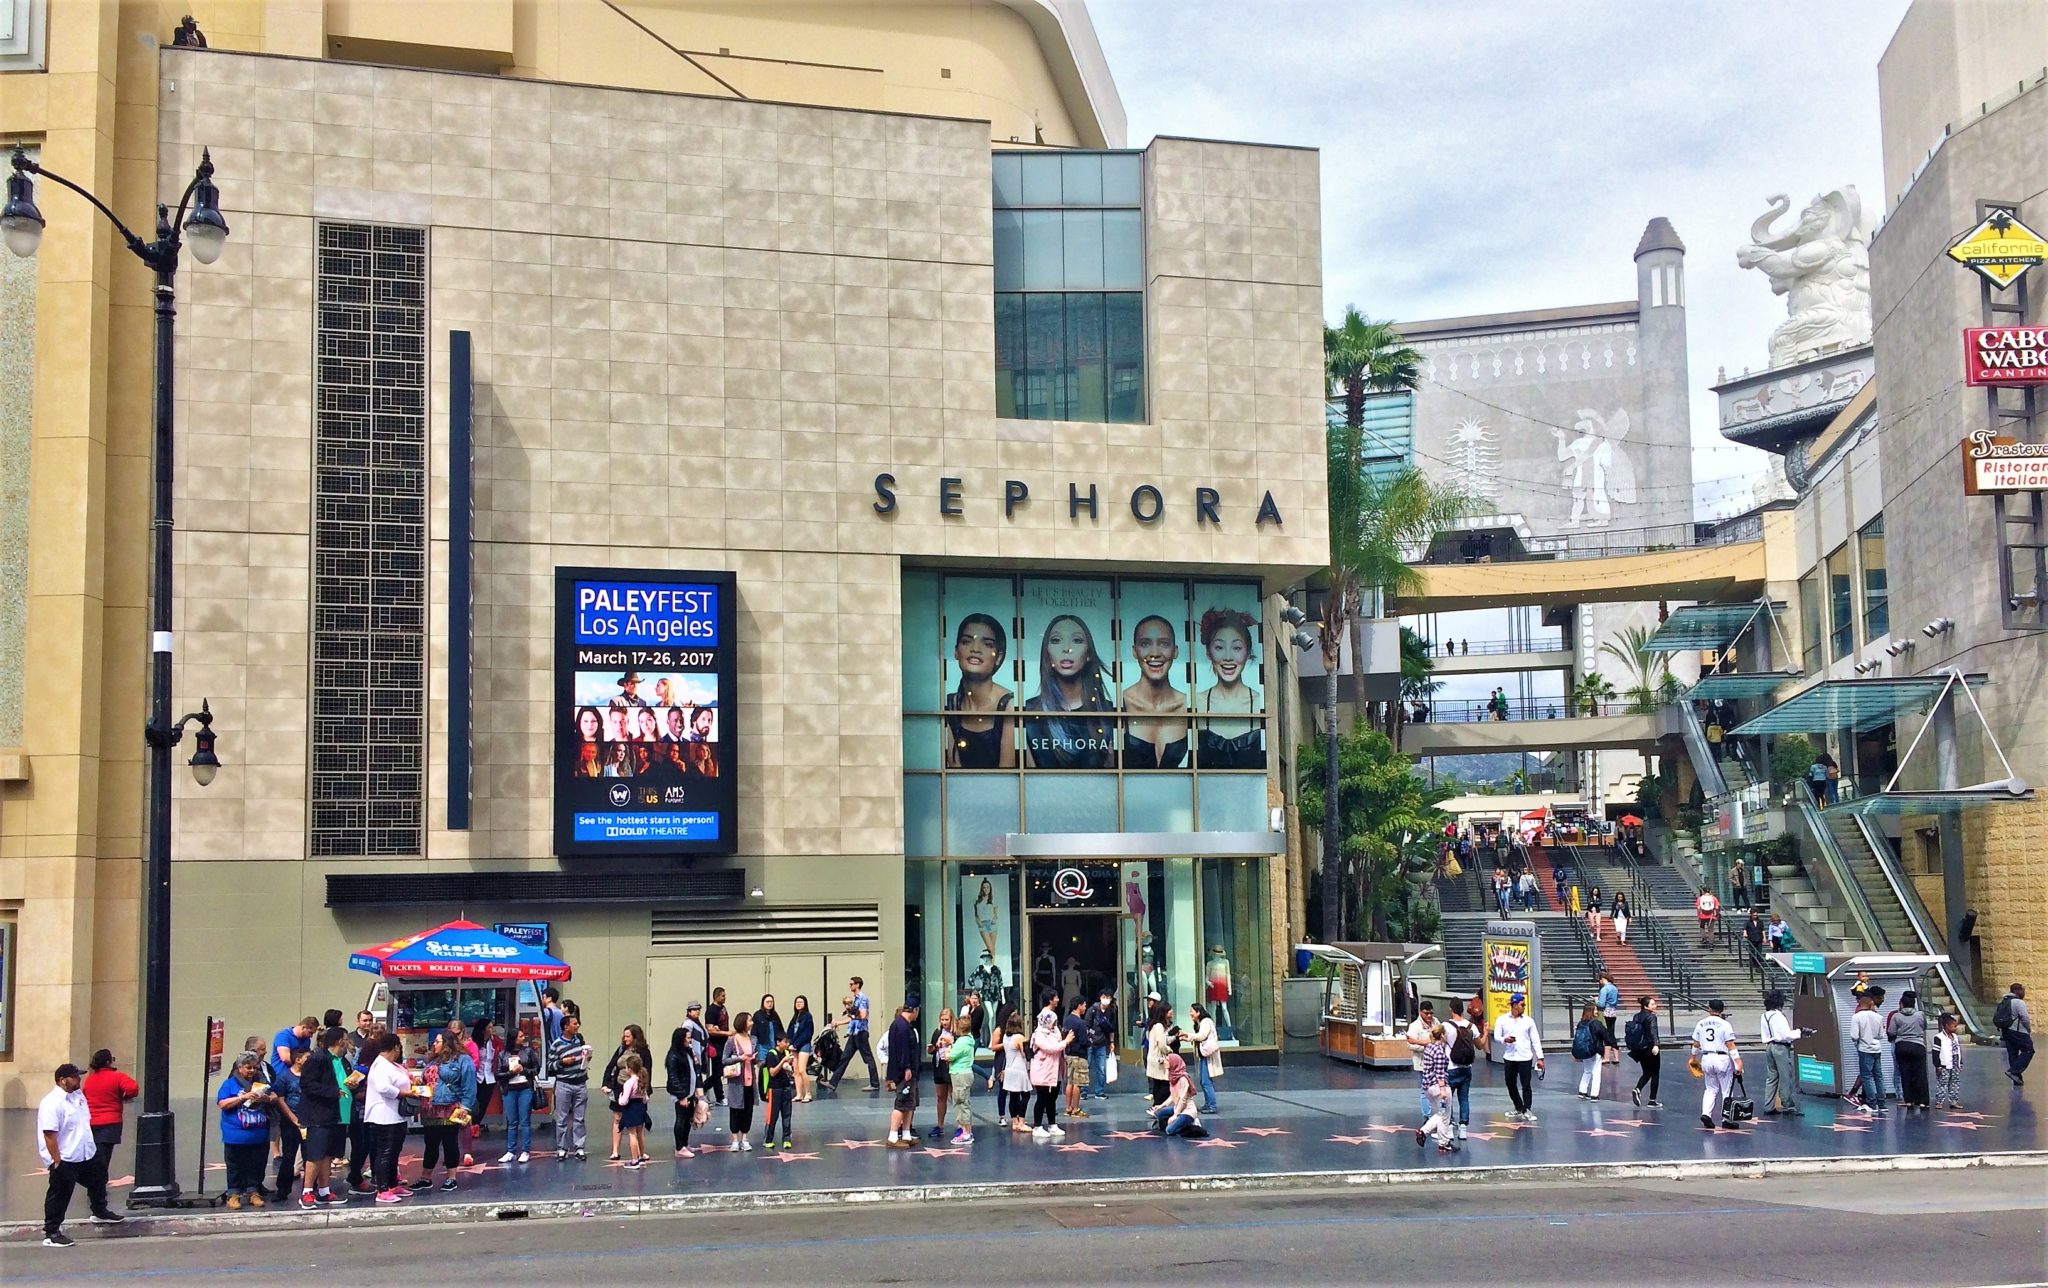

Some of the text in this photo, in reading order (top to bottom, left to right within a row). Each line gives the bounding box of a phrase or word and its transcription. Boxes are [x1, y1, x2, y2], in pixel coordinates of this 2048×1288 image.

[1962, 243, 2044, 255] california
[1980, 369, 2047, 378] CANTIN
[873, 473, 1283, 525] SEPHORA
[580, 588, 713, 613] PALEYFEST
[580, 612, 714, 642] Los Angeles
[578, 651, 714, 667] March 17-26, 2017
[1031, 738, 1109, 751] SEPHORA
[646, 795, 659, 804] US
[579, 816, 715, 826] See the hottest stars in person!
[619, 827, 689, 836] DOLBY THEATRE
[1053, 868, 1094, 899] Q
[1488, 926, 1533, 936] IRECTORY
[388, 964, 464, 972] TICKETS BOLETOS
[491, 966, 522, 974] KARTEN
[1705, 1028, 1715, 1042] 3
